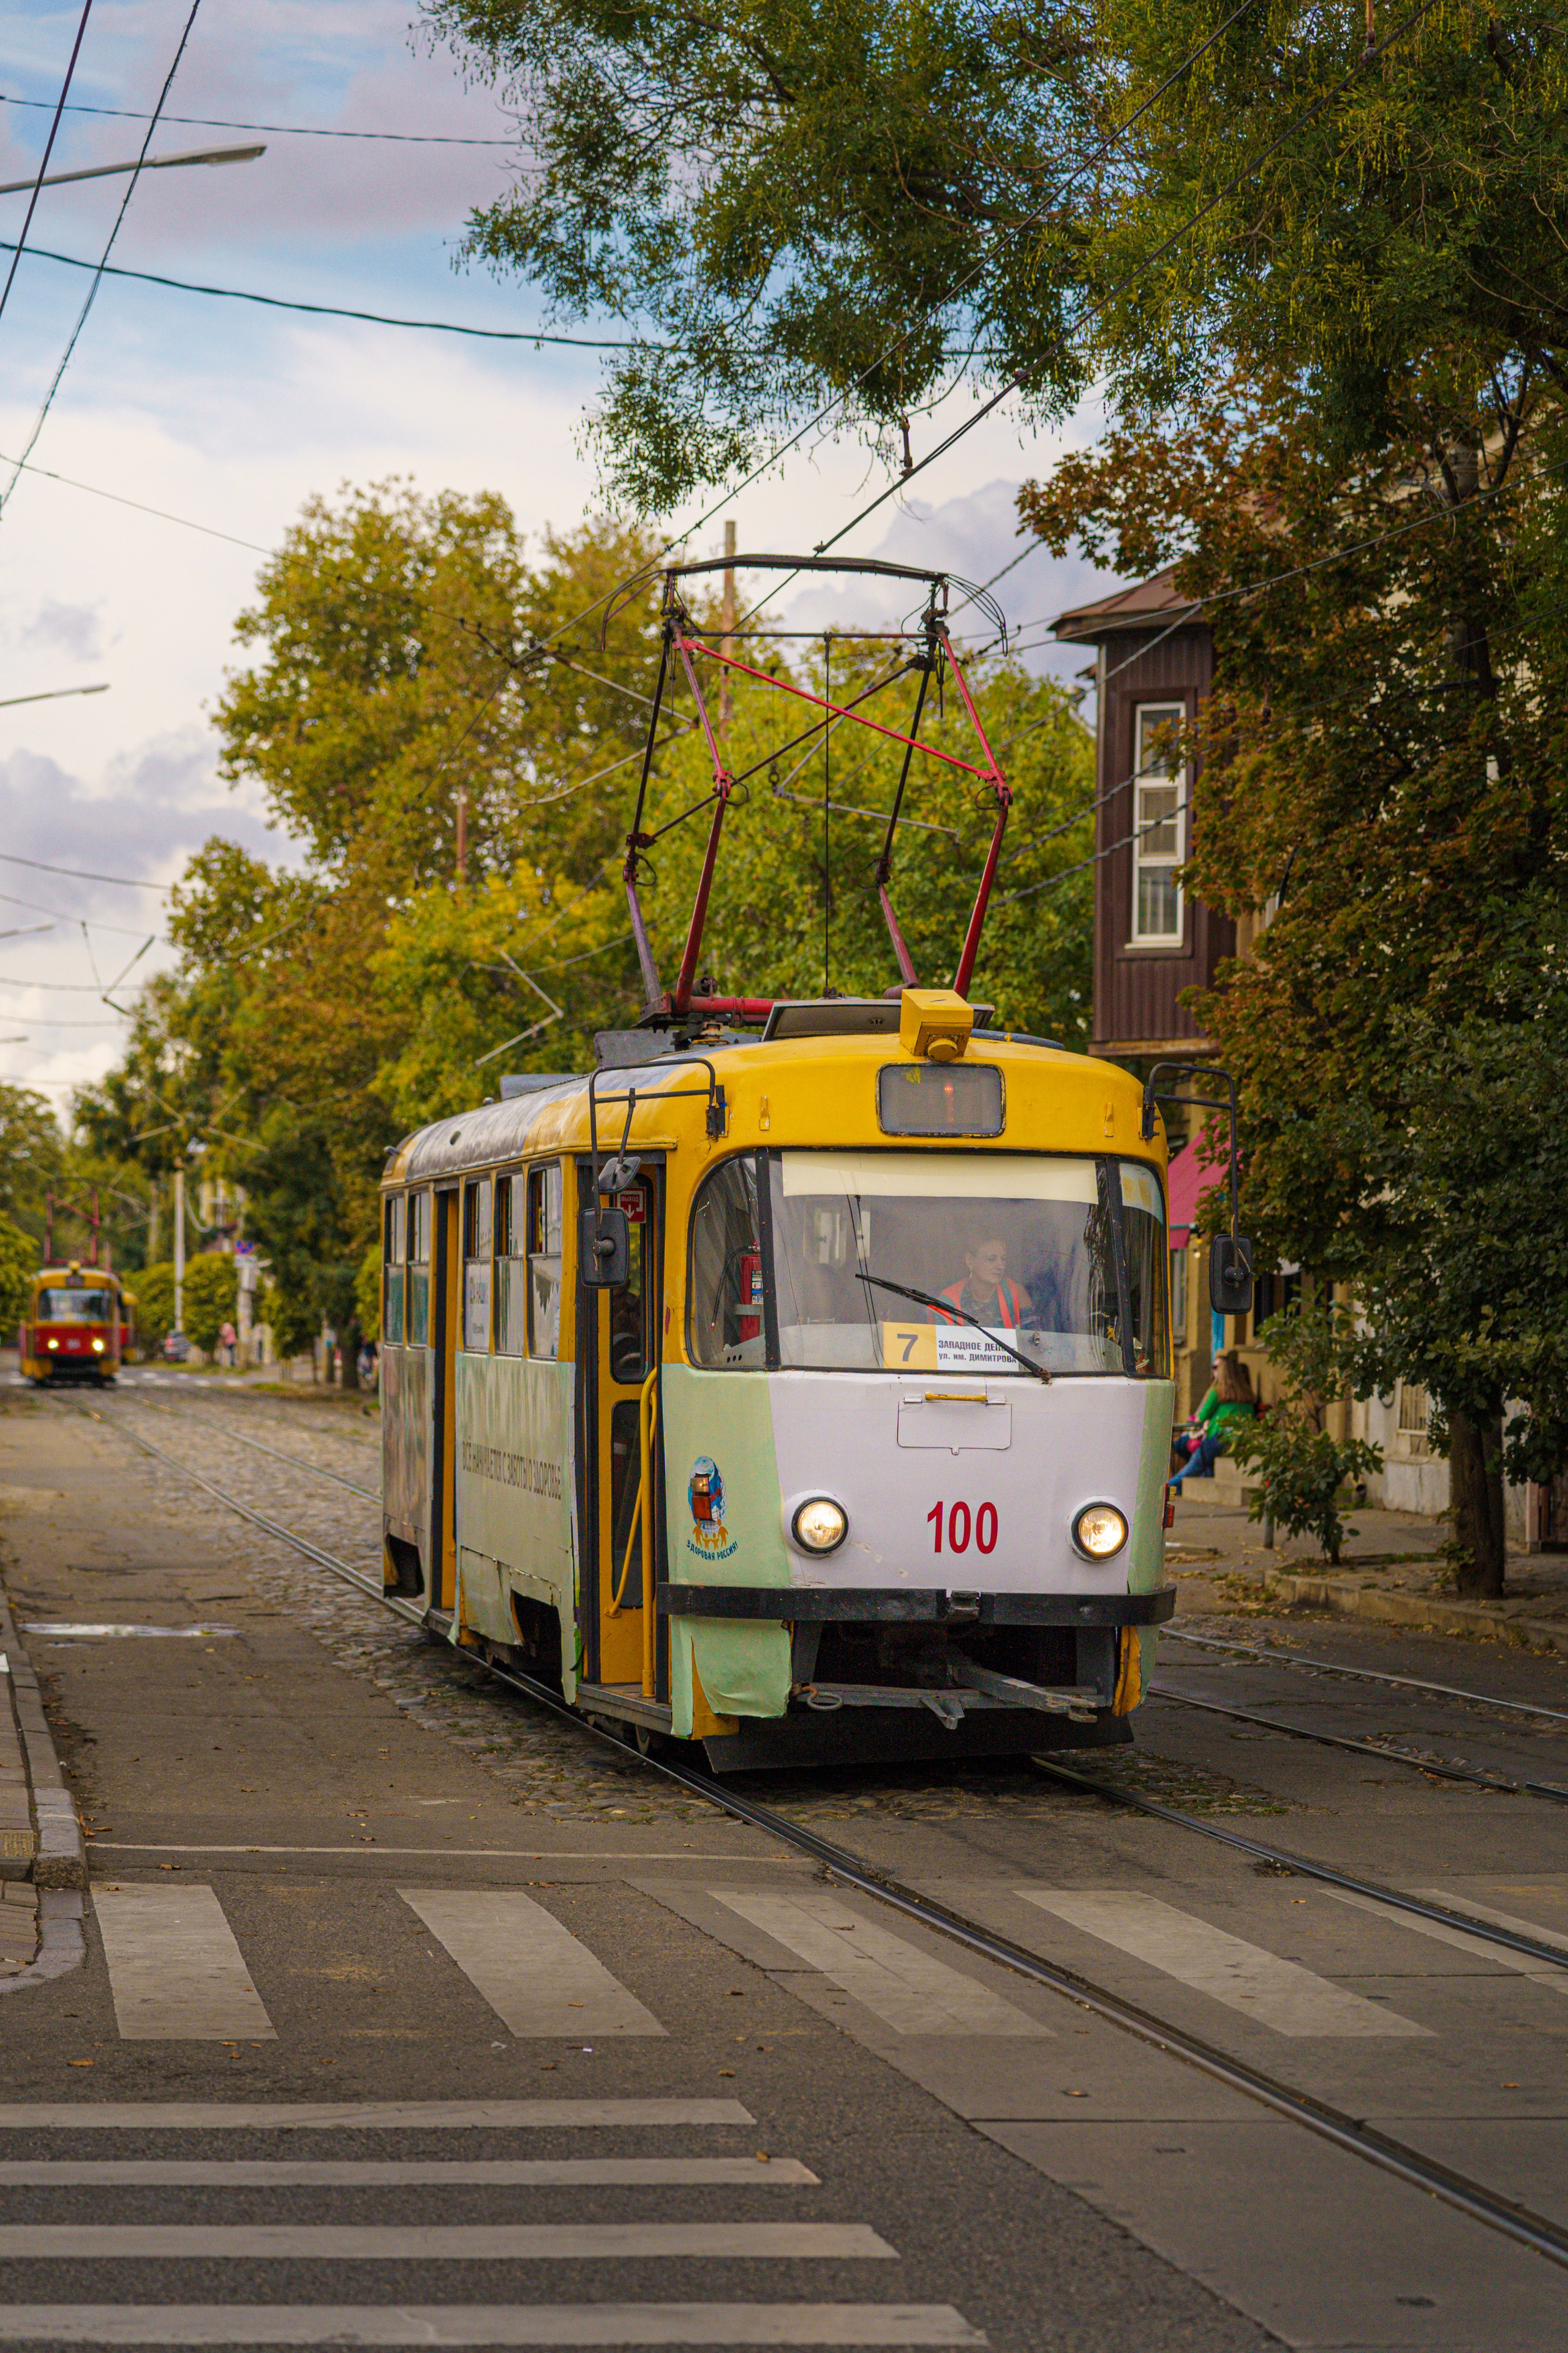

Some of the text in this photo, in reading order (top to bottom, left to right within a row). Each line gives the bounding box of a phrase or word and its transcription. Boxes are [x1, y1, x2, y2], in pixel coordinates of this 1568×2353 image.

[897, 1334, 918, 1362] 7
[938, 1340, 982, 1351] ЗАПАДНОЕ
[969, 1353, 1017, 1363] ДИМИТРОВА
[507, 1452, 527, 1490] ЗАБОТЫ
[533, 1459, 561, 1500] ЗДОРОВЬЕ
[927, 1501, 998, 1554] 100
[686, 1539, 739, 1561] ЗДОРОВАЯ РОССИЯ!
